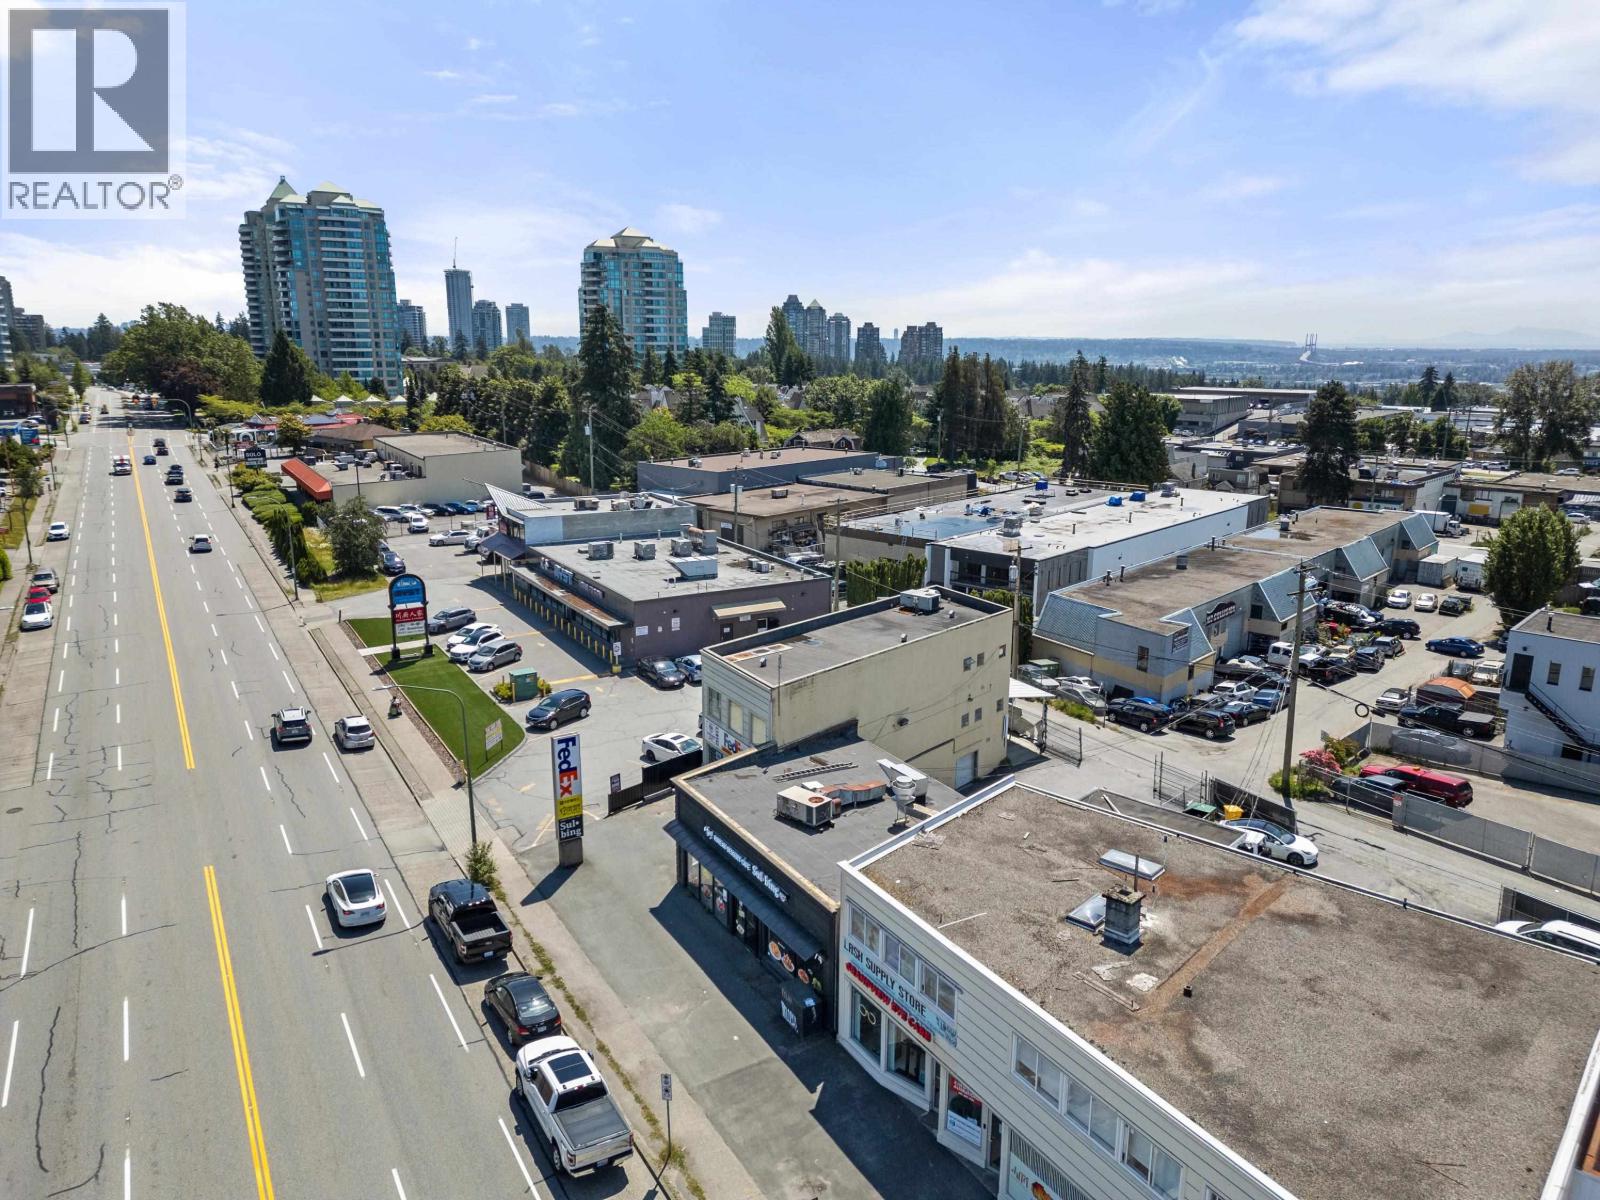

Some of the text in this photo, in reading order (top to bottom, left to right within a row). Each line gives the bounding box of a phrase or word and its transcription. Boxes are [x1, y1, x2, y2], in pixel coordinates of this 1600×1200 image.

[557, 736, 578, 798] FedEx
[560, 828, 582, 839] bing
[843, 938, 927, 1018] LASH SUPPLY STORE
